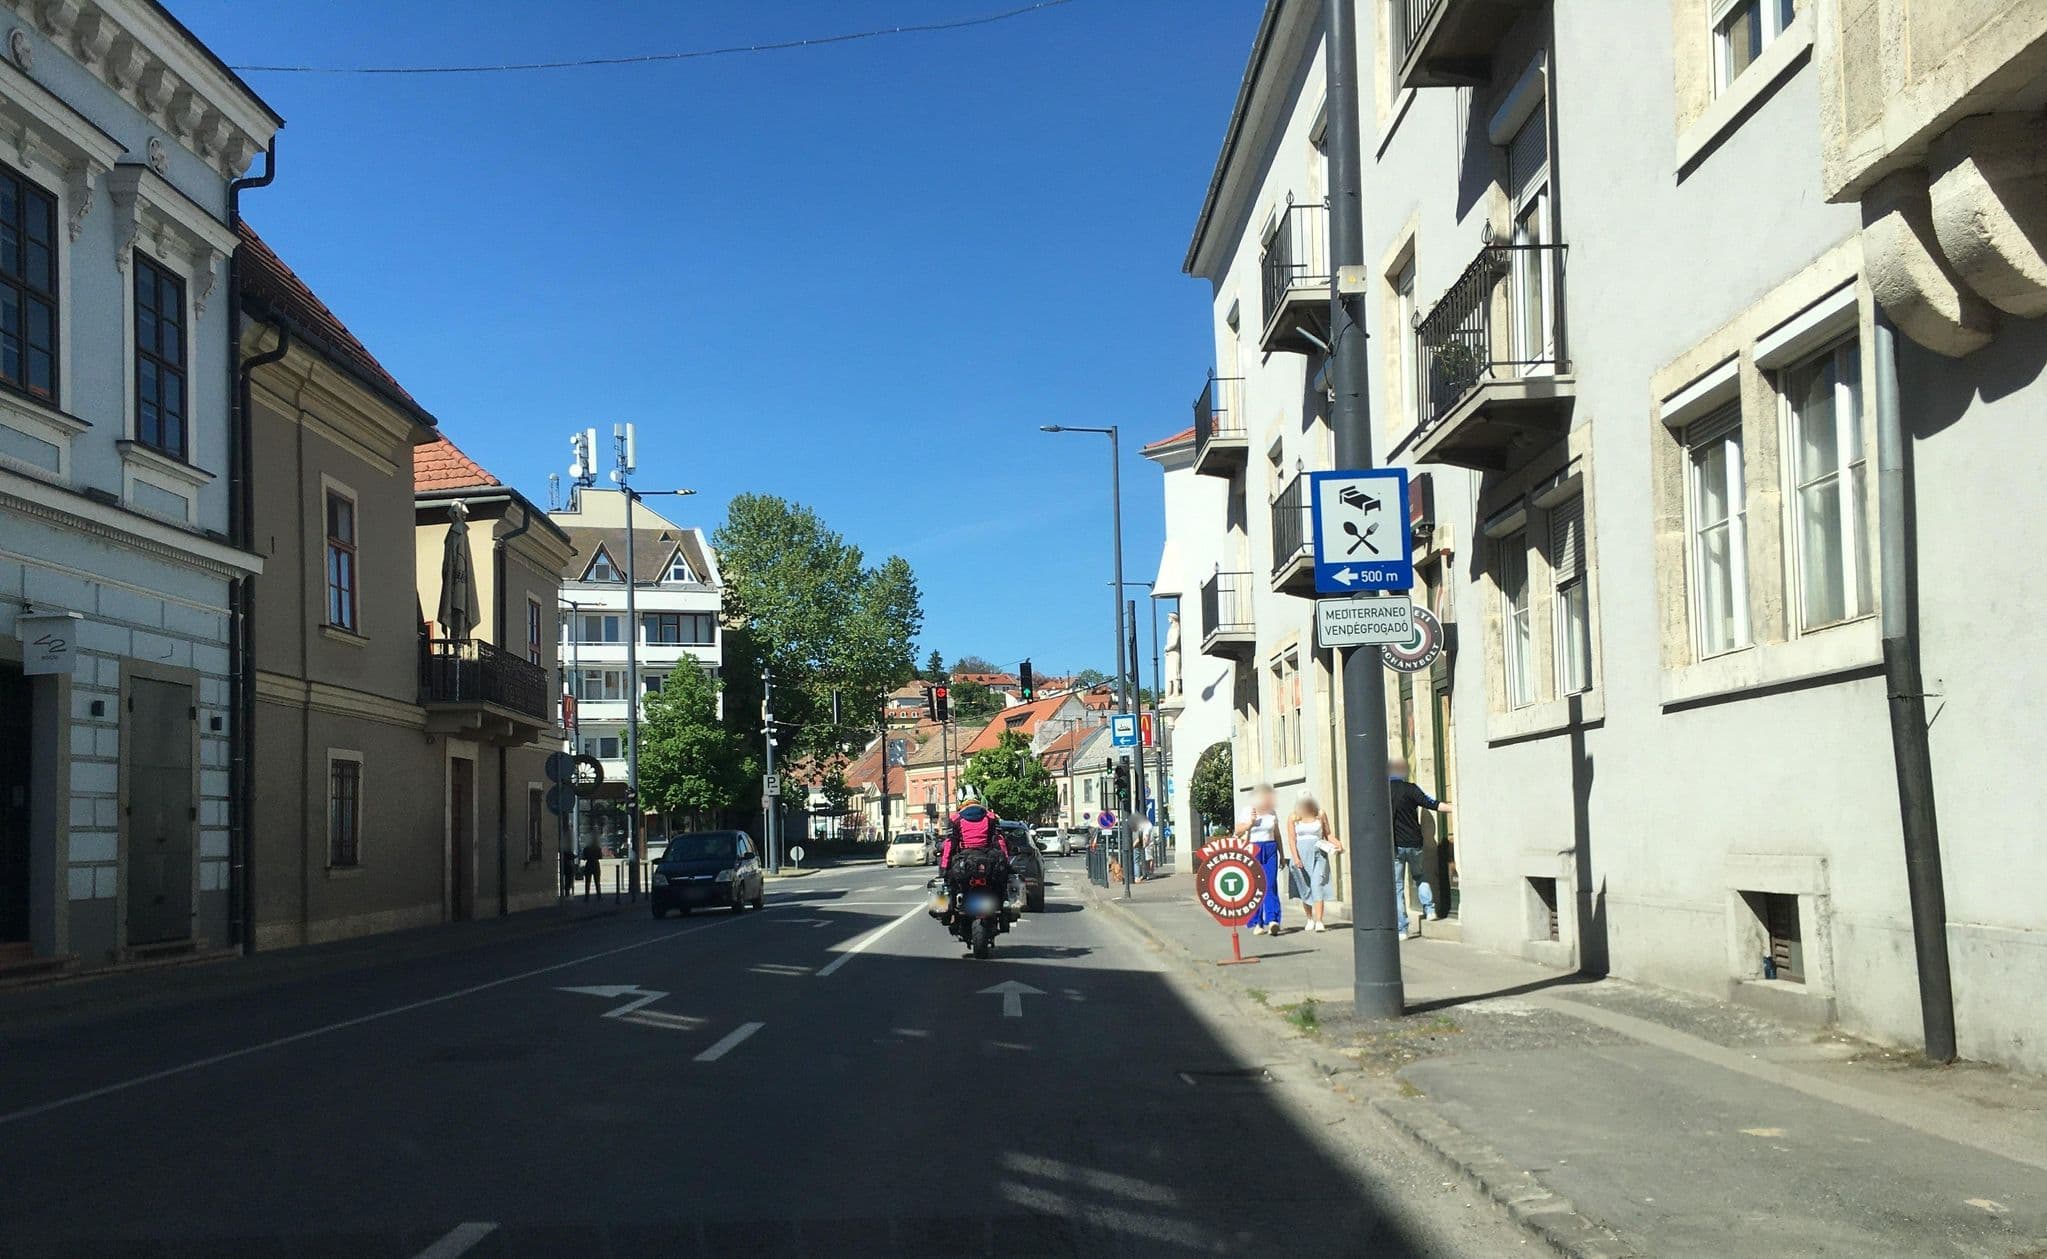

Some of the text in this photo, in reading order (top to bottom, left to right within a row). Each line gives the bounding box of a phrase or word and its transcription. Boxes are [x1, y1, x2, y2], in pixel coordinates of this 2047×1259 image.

[1361, 570, 1398, 582] 500 m
[1326, 607, 1406, 620] MEDITERRANEO
[1325, 620, 1408, 636] VENDÉGFOGADÓ
[1202, 838, 1254, 856] NYITVA
[1207, 852, 1254, 870] NEMZETI
[1224, 878, 1238, 892] T
